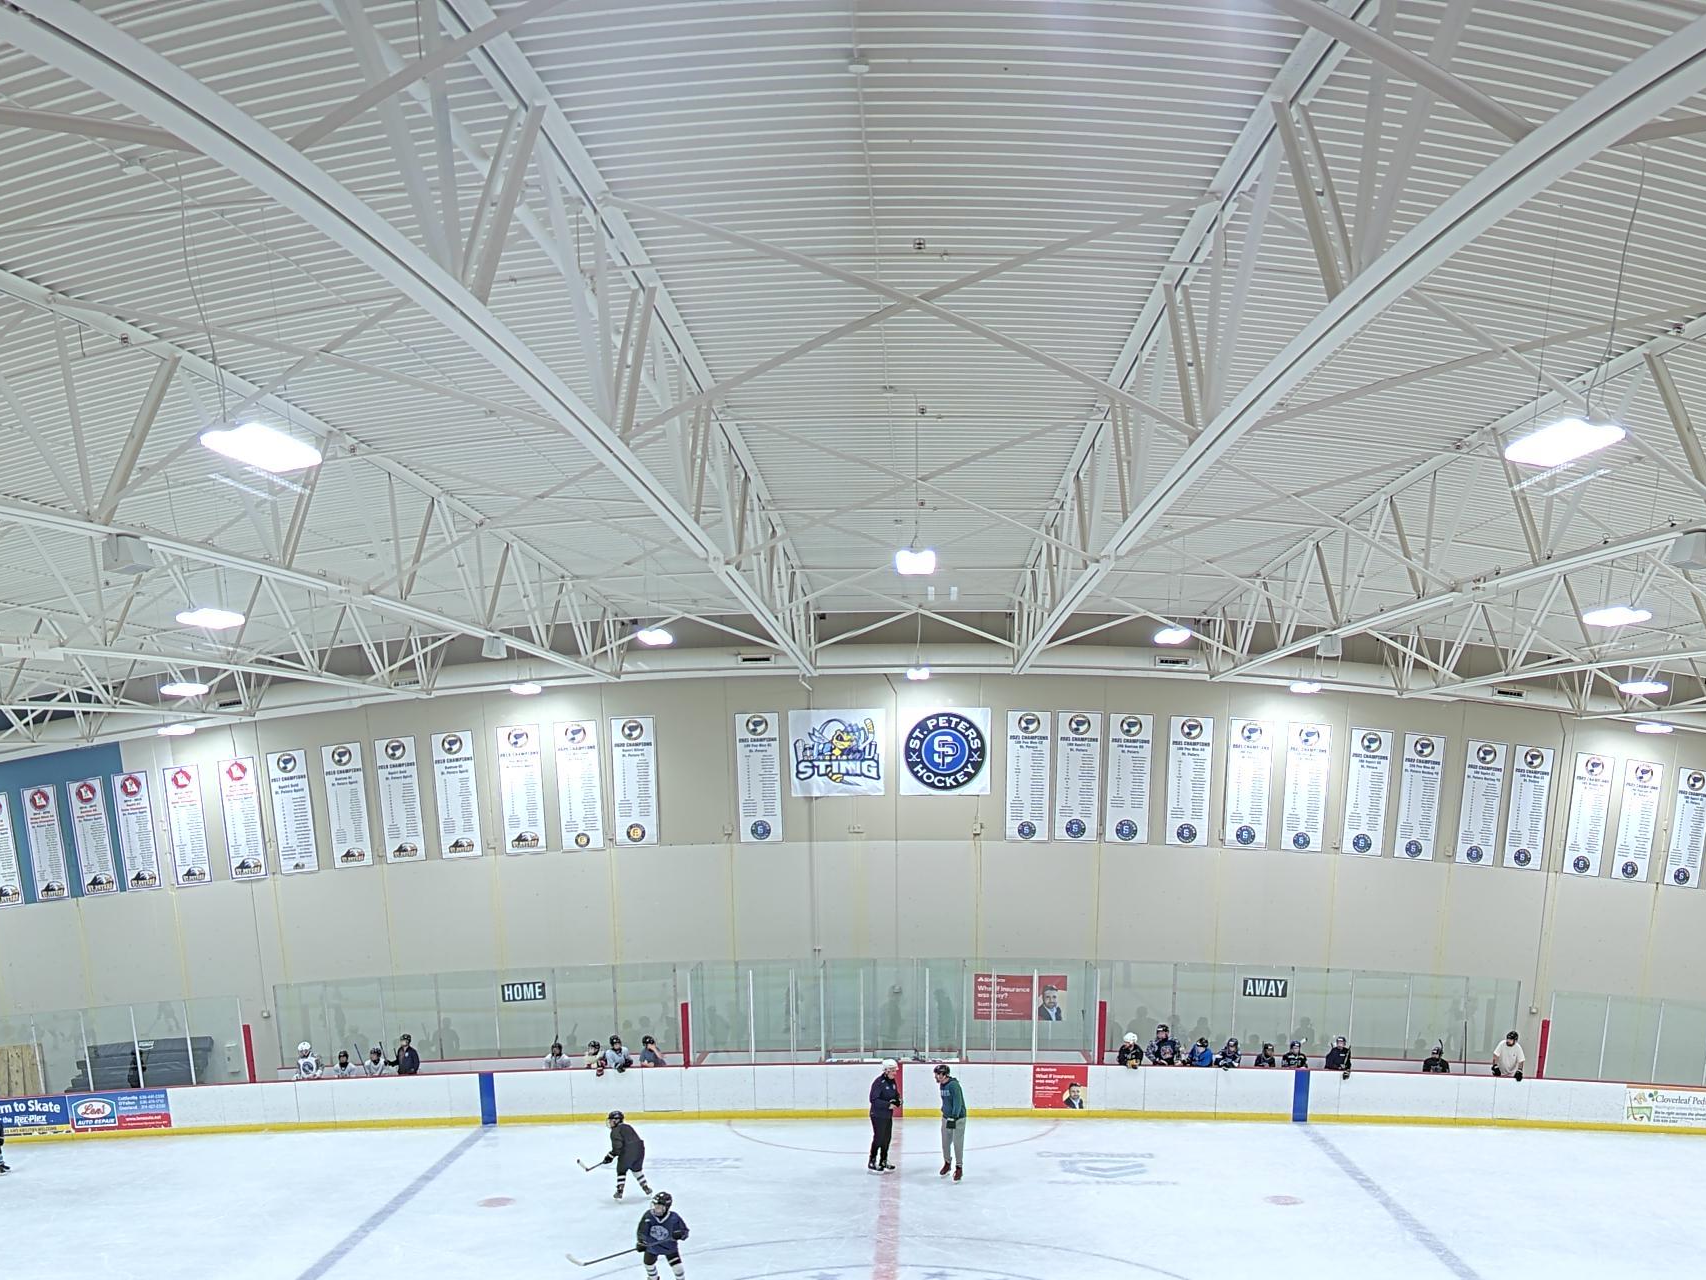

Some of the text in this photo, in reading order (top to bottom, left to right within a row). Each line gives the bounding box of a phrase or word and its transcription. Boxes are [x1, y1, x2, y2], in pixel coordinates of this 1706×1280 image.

[909, 716, 982, 750] ST. PETERS
[281, 774, 306, 782] CHAMPIONS
[796, 760, 881, 781] STING
[913, 764, 976, 787] HOCKEY
[504, 983, 543, 1000] HOME
[1245, 979, 1285, 997] AWAY
[13, 1101, 24, 1112] to
[27, 1100, 61, 1113] Skate
[1655, 1095, 1692, 1105] Cloverleaf
